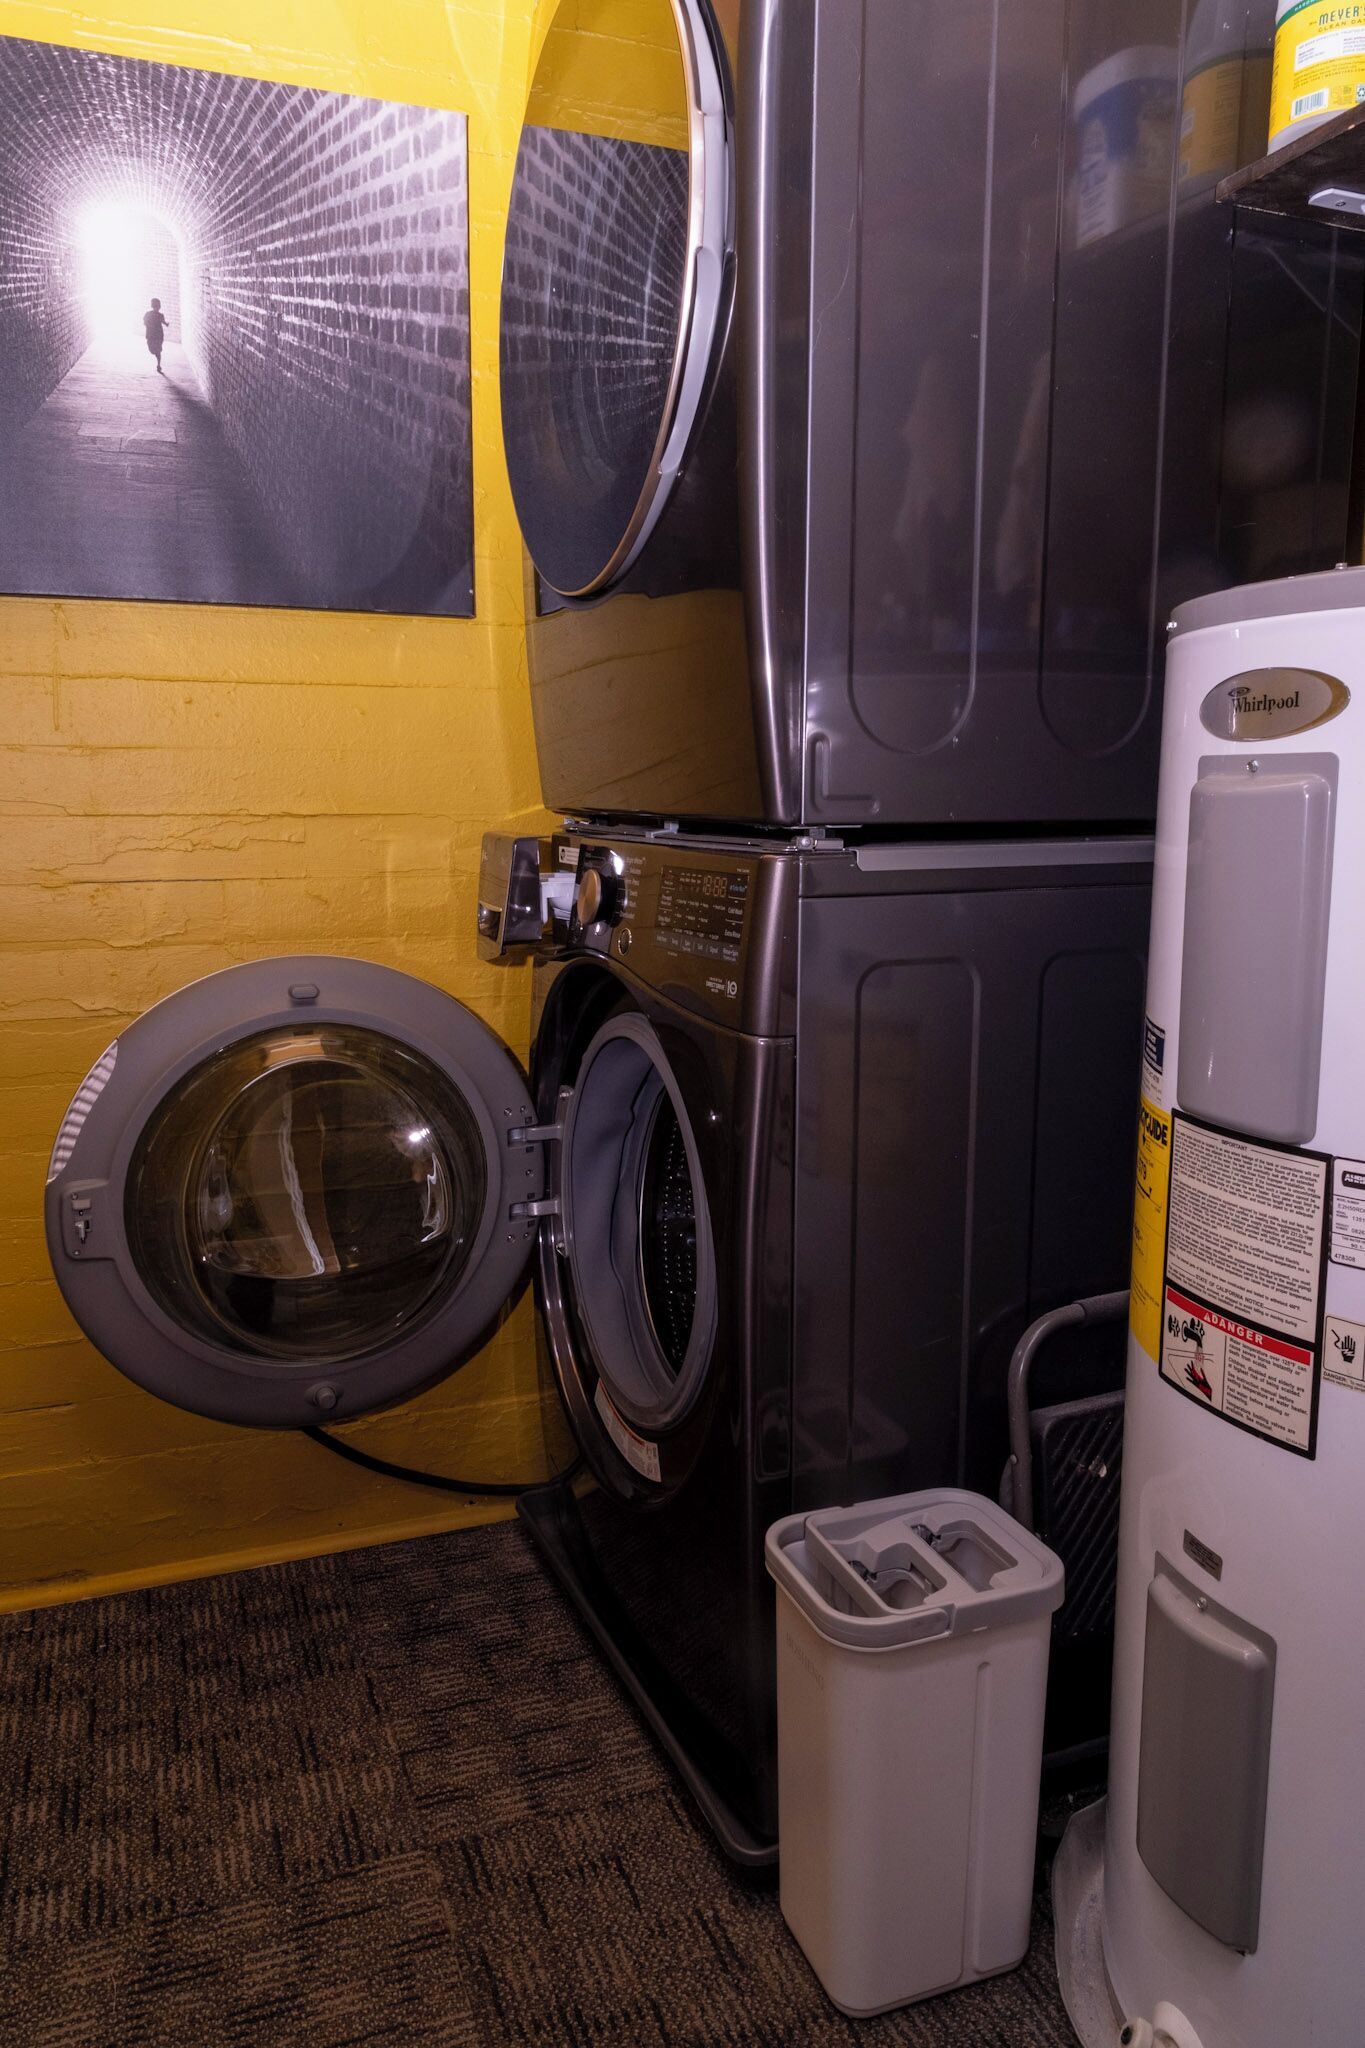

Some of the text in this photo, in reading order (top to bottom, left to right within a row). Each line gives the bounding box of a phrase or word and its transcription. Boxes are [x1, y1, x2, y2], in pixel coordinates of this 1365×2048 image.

[1319, 4, 1365, 26] MEYER'
[1318, 20, 1346, 32] CLEAN
[1231, 690, 1300, 714] Whirlpool
[1221, 1139, 1247, 1151] IMPORTANT
[1334, 1252, 1356, 1263] 478308
[1244, 1295, 1264, 1308] NOTICE
[1211, 1313, 1264, 1345] DANGER
